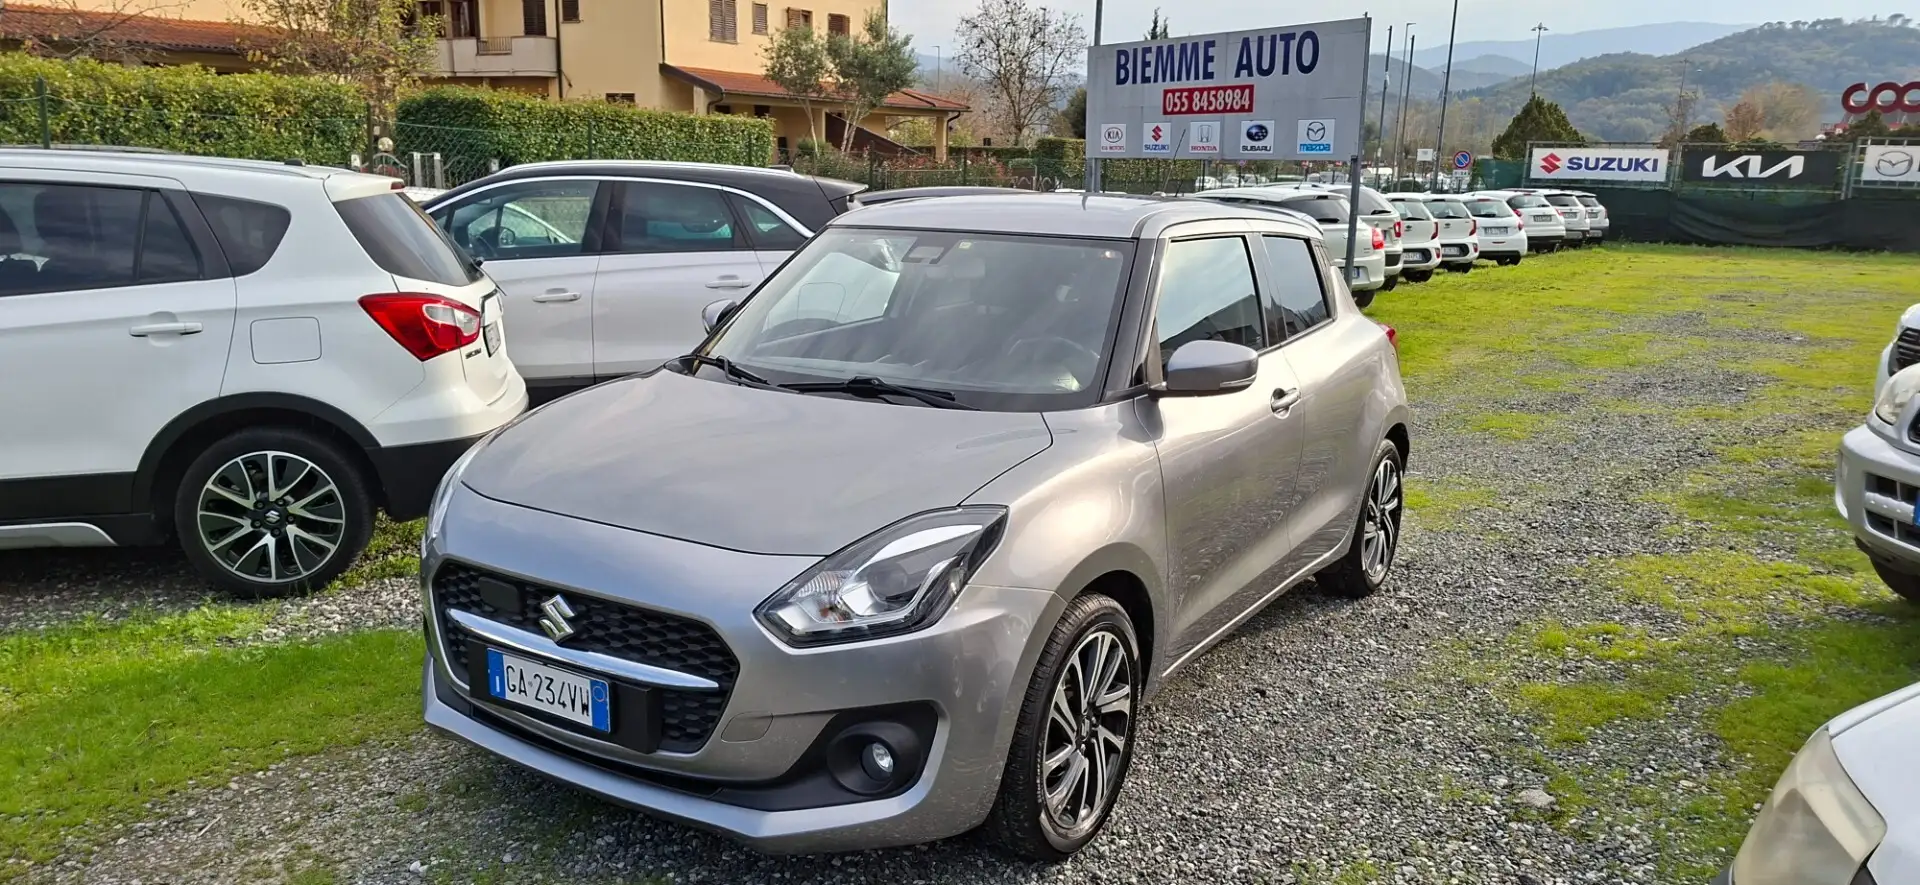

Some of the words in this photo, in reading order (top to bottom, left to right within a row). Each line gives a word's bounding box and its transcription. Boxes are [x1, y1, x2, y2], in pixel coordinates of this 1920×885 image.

[1115, 39, 1216, 86] BIEMME
[1234, 30, 1320, 79] AUTO
[1165, 92, 1189, 113] 055
[1192, 88, 1251, 112] 8458984
[1107, 130, 1120, 140] KIA
[1566, 156, 1659, 173] SUZUKI
[1702, 155, 1805, 179] KIA
